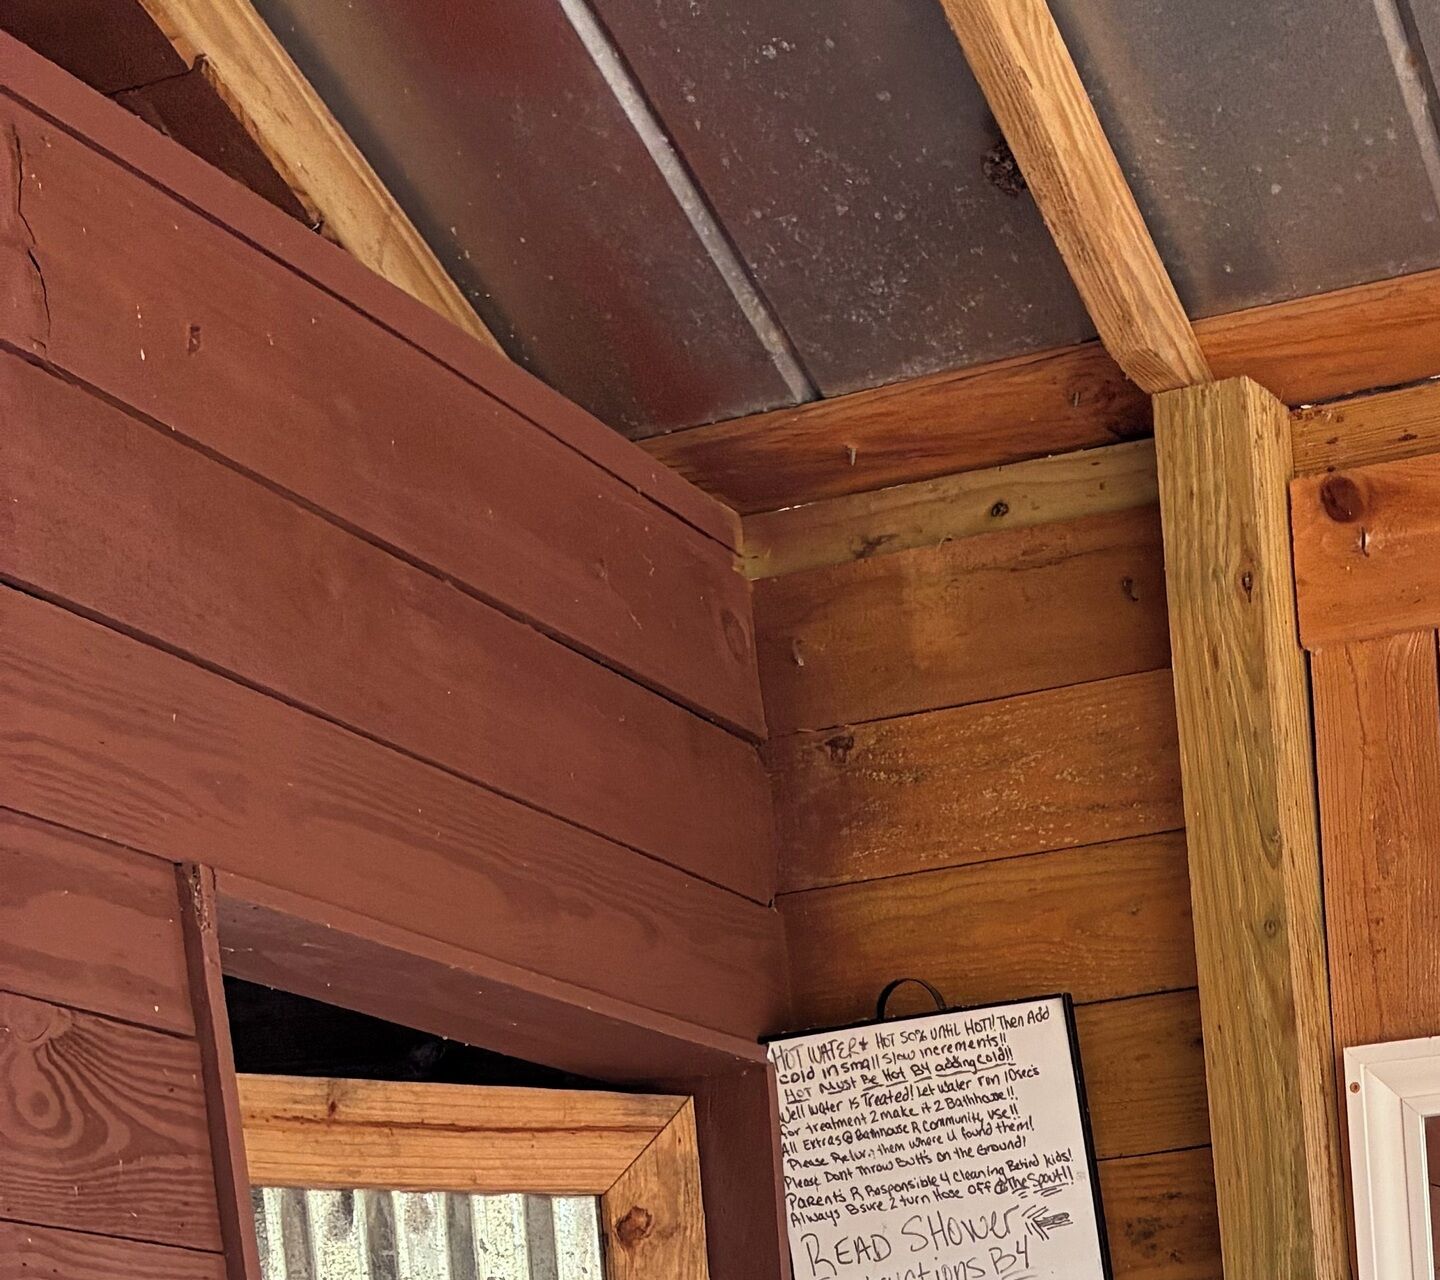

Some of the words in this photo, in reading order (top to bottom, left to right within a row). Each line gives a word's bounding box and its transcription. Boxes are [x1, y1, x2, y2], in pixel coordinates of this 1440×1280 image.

[771, 1043, 803, 1073] HOT
[997, 1014, 1025, 1030] Then
[1027, 1006, 1050, 1025] Add
[935, 1055, 977, 1075] adding
[860, 1084, 914, 1108] Treated!
[805, 1112, 867, 1135] treatment
[880, 1105, 919, 1121] make
[934, 1099, 944, 1112] 2
[782, 1143, 798, 1158] All
[787, 1157, 829, 1171] Please
[877, 1143, 905, 1157] them
[995, 1115, 1035, 1134] them!
[953, 1145, 975, 1160] the
[850, 1186, 864, 1201] R
[940, 1171, 950, 1186] 4
[790, 1209, 840, 1228] Always
[899, 1193, 930, 1208] turn
[801, 1233, 892, 1276] READ
[989, 1234, 1029, 1274] B4
